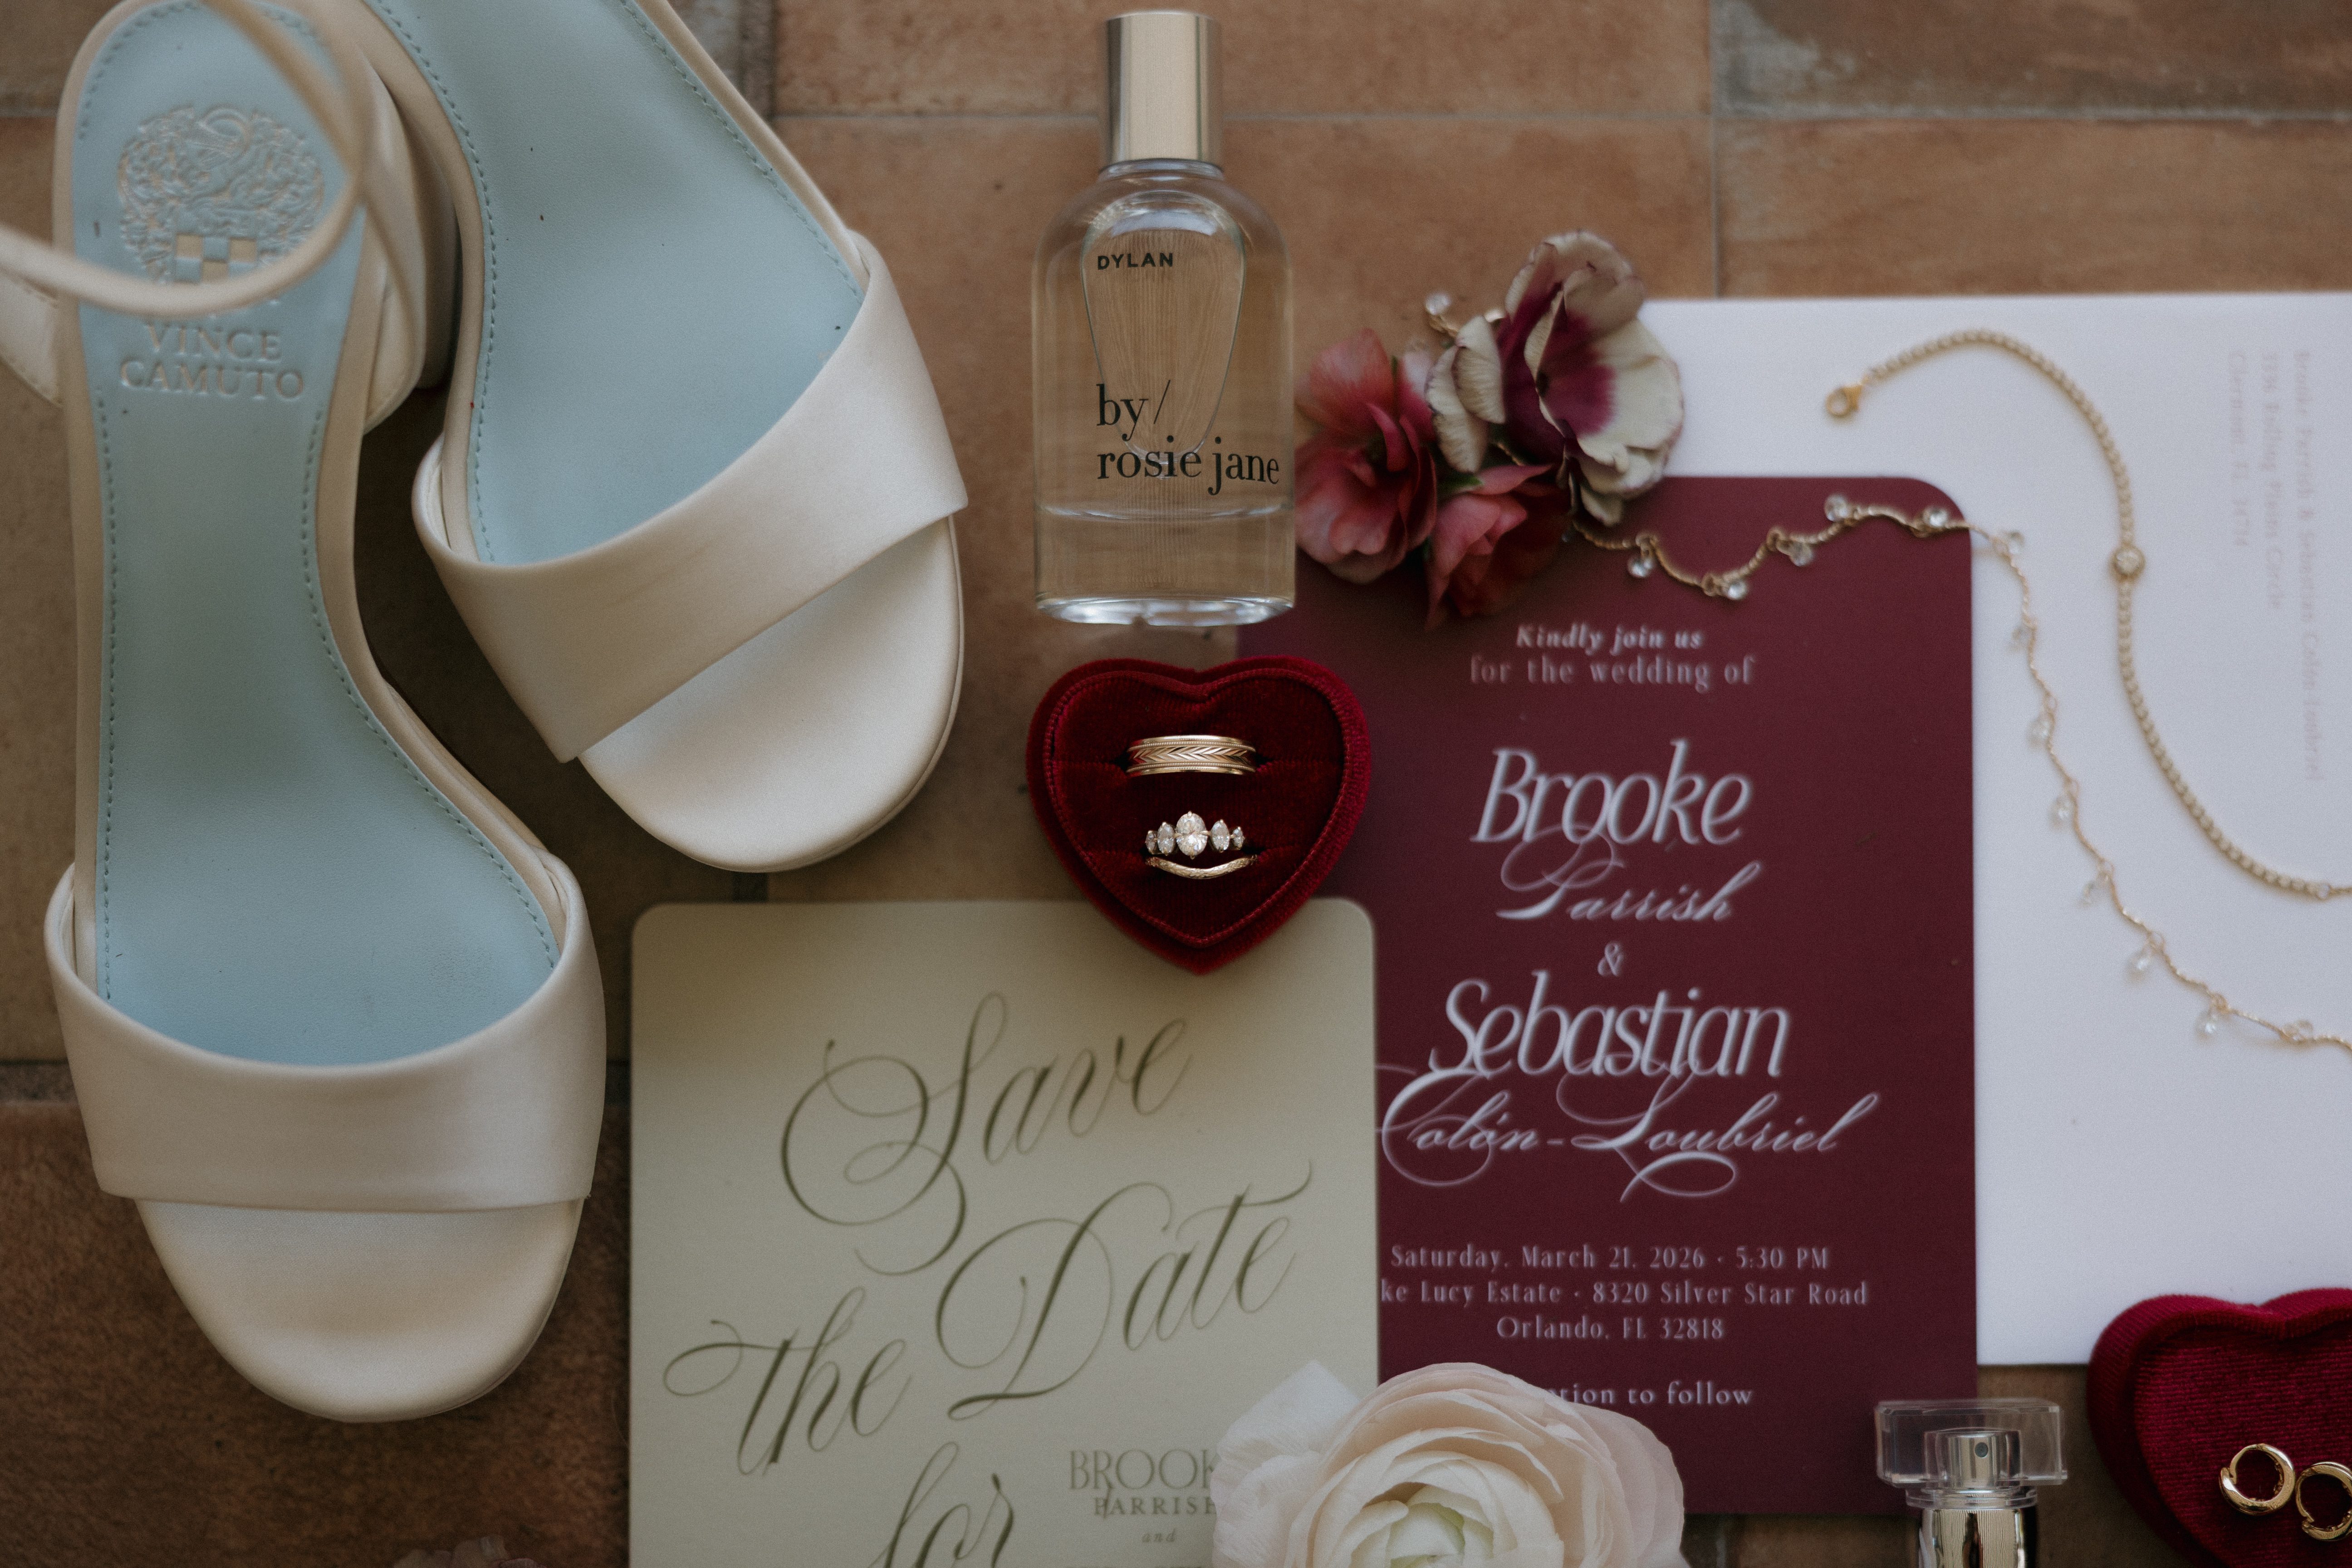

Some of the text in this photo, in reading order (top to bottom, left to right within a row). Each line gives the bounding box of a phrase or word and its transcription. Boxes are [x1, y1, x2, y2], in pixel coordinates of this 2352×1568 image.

[1097, 252, 1173, 270] DYLAN
[144, 321, 282, 362] VINCE
[119, 360, 304, 401] CAMUTO
[1097, 435, 1279, 496] rosie jane
[1516, 623, 1703, 656] Kindly join us
[1470, 655, 1757, 694] for the wedding of
[1469, 737, 1752, 846] Brooke
[1496, 824, 1762, 921] Parrish
[1597, 941, 1623, 976] &
[1428, 969, 1790, 1079] Sebastian
[780, 991, 1194, 1275] Save
[1522, 1244, 1597, 1268] March
[1650, 1246, 1705, 1269] 2026
[1735, 1245, 1785, 1269] 5:30
[1797, 1247, 1830, 1269] PM
[936, 1157, 1313, 1421] Date
[1381, 1279, 1407, 1302] ke
[1421, 1280, 1474, 1308] Lucy
[1487, 1280, 1562, 1303] Estate
[1592, 1282, 1650, 1303] 8320
[1660, 1280, 1732, 1304] Silver
[1744, 1282, 1795, 1305] Star
[1808, 1280, 1869, 1305] Road
[1622, 1317, 1646, 1340] FL
[1659, 1317, 1725, 1340] 32818
[662, 1285, 913, 1477] the
[1547, 1380, 1754, 1405] tion to follow
[1069, 1449, 1223, 1490] BROOK
[1142, 1528, 1178, 1544] and
